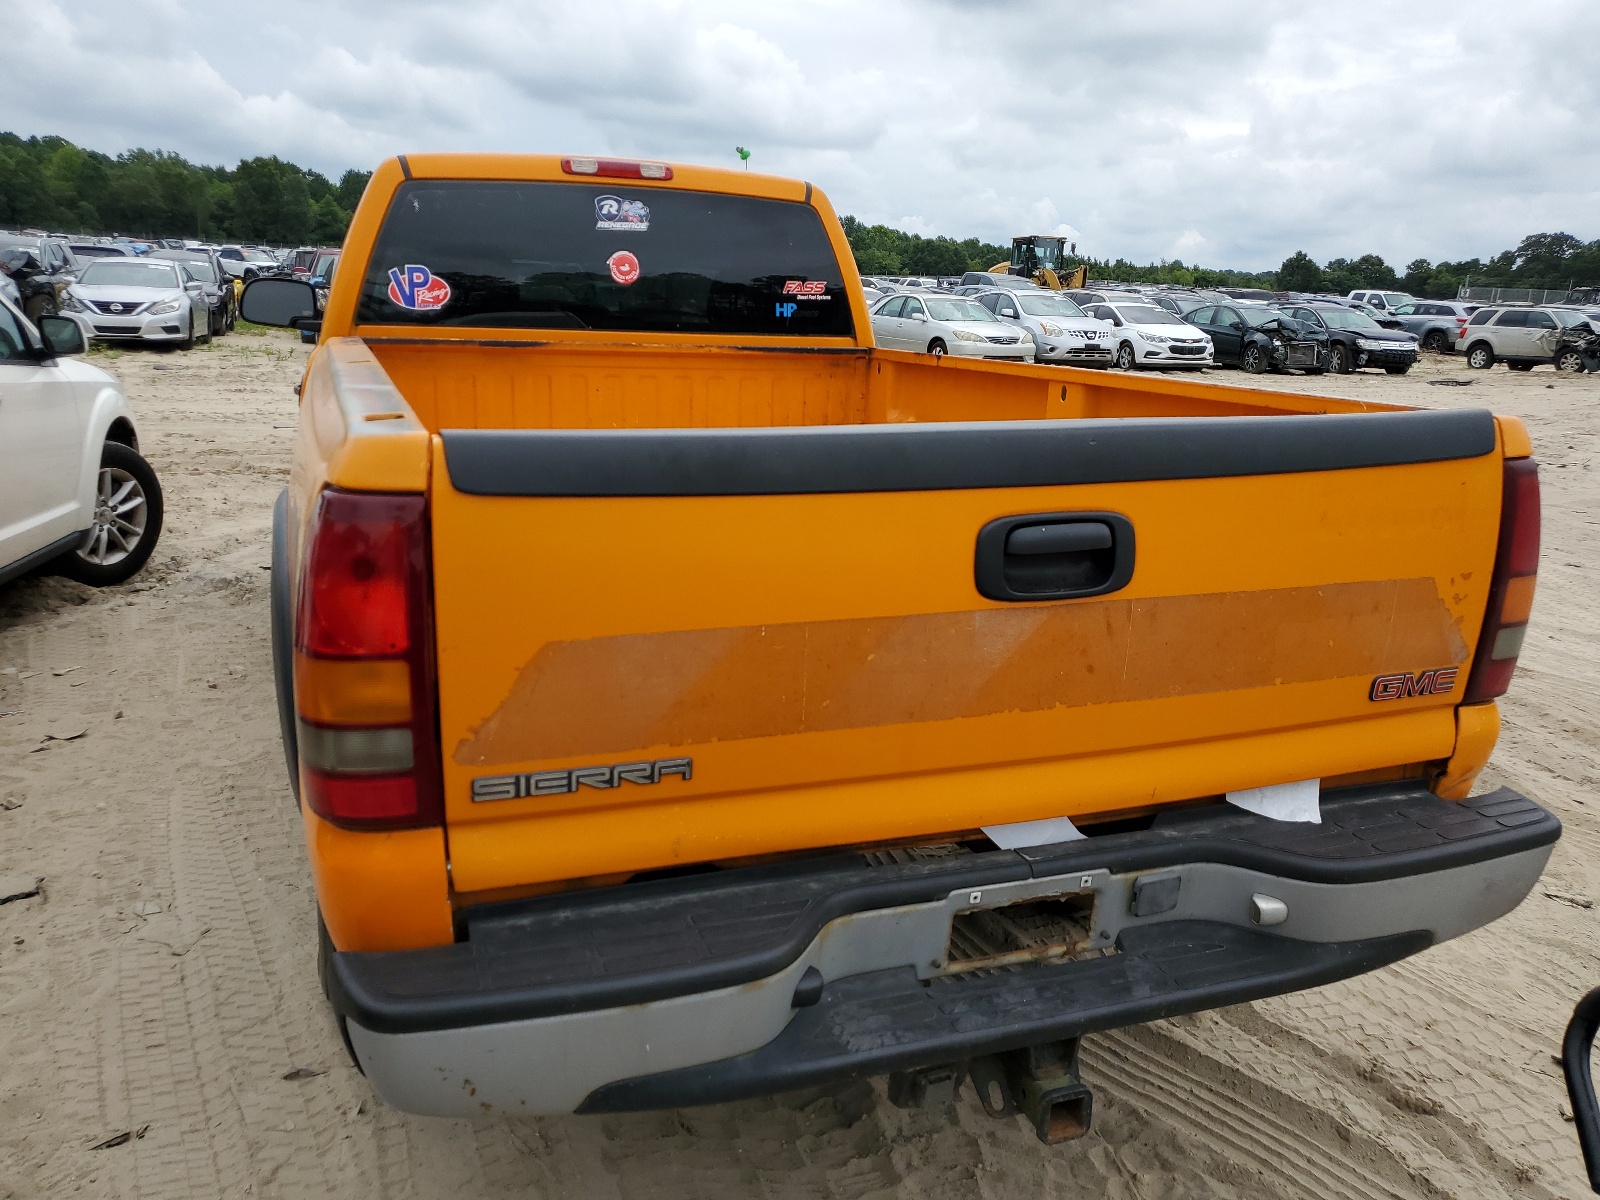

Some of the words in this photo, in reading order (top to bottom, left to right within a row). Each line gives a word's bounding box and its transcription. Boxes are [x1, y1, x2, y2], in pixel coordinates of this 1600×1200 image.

[599, 199, 619, 214] R
[597, 221, 648, 229] RENEGADE
[388, 265, 432, 308] VP
[782, 280, 827, 294] FASS
[418, 288, 448, 303] Racing
[775, 302, 797, 318] HP
[1369, 666, 1458, 701] GMC
[472, 757, 692, 802] SIERRA
